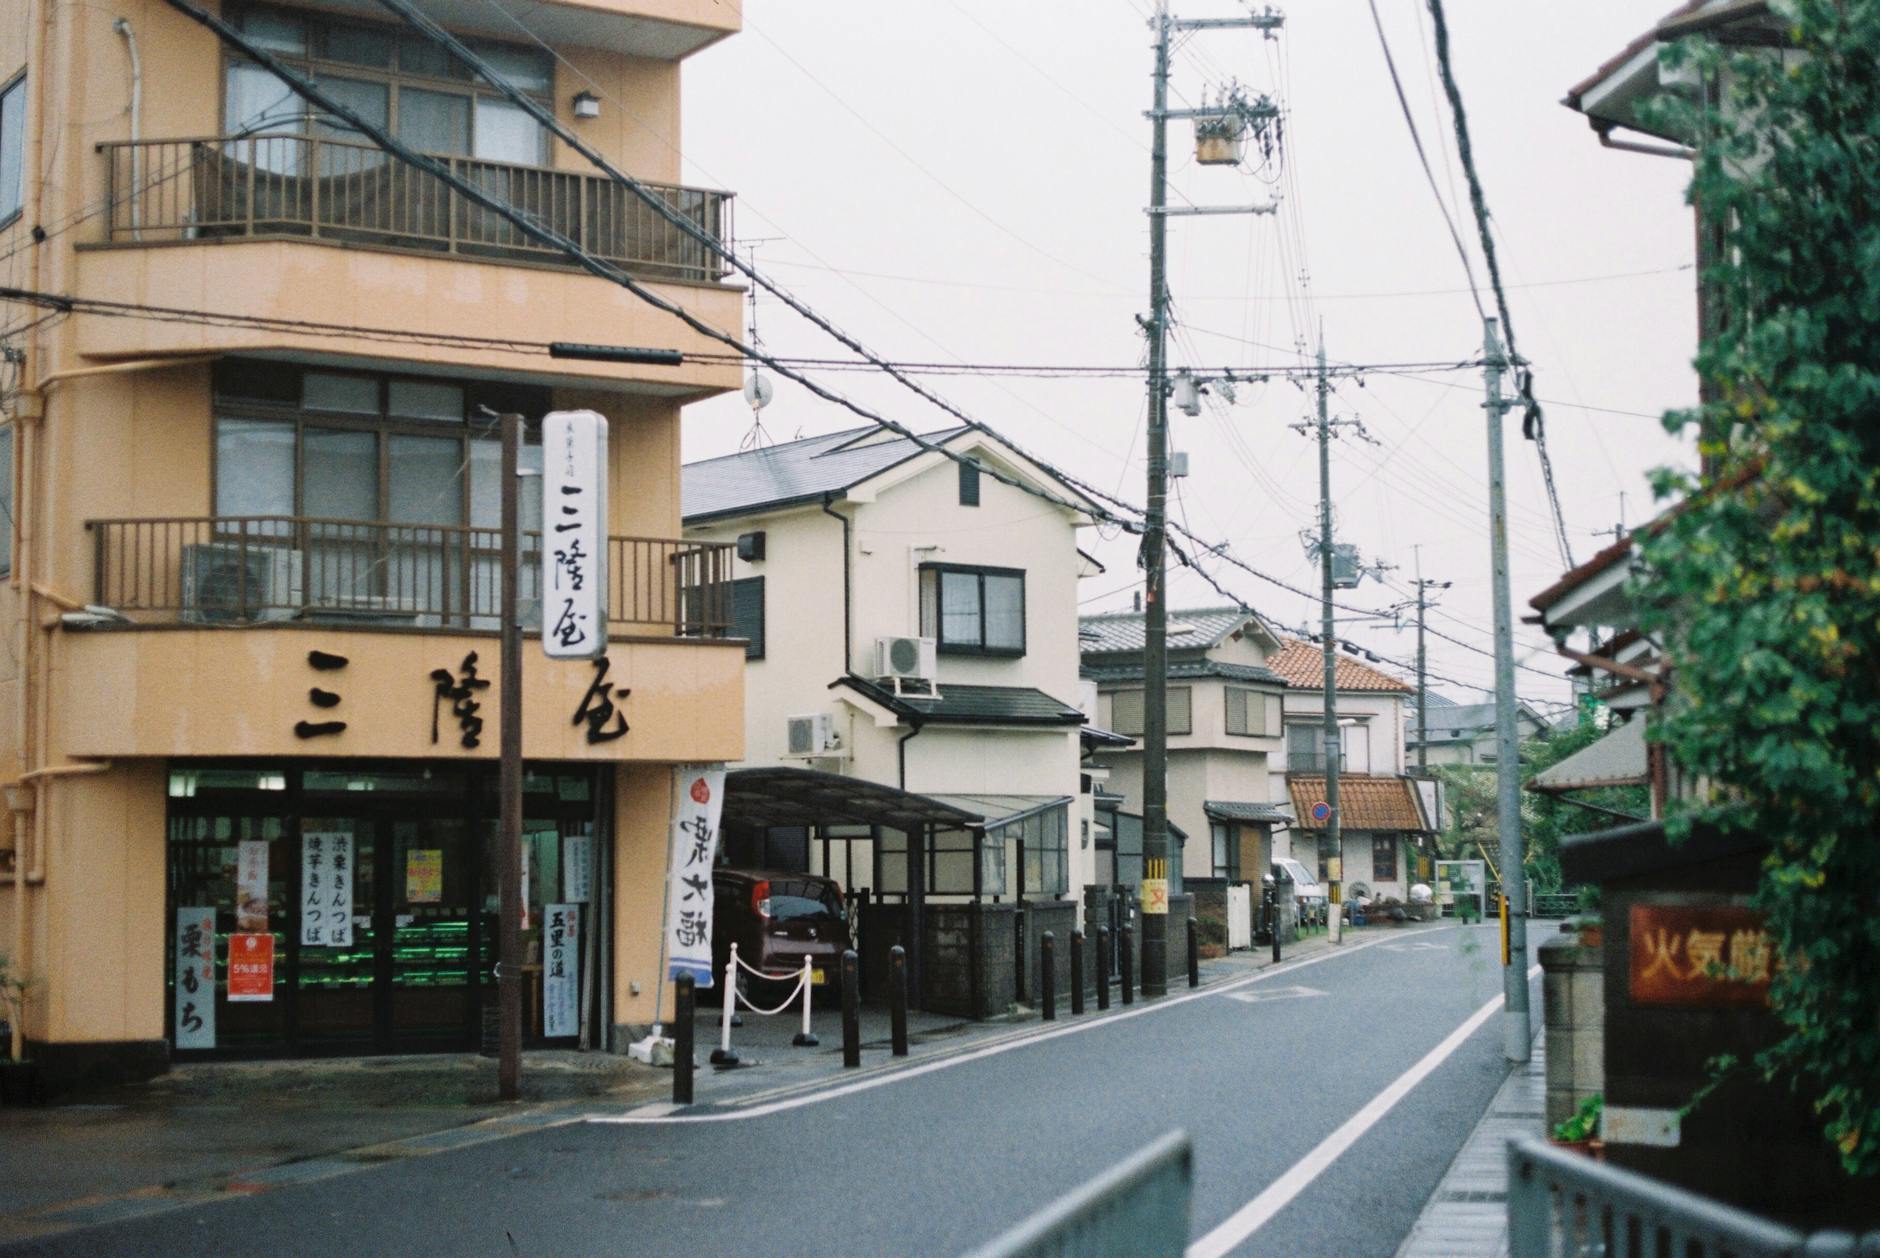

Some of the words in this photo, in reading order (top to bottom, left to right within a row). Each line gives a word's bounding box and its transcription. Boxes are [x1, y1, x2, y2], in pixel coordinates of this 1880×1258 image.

[553, 485, 586, 647] 三隆屋
[294, 651, 631, 749] 三隆屋
[306, 836, 323, 942] 焼芋きんつば
[332, 835, 347, 943] 渋栗きんつば
[181, 924, 203, 1033] 栗もち
[549, 911, 566, 978] 五里の道
[1641, 927, 1784, 981] 火気厳
